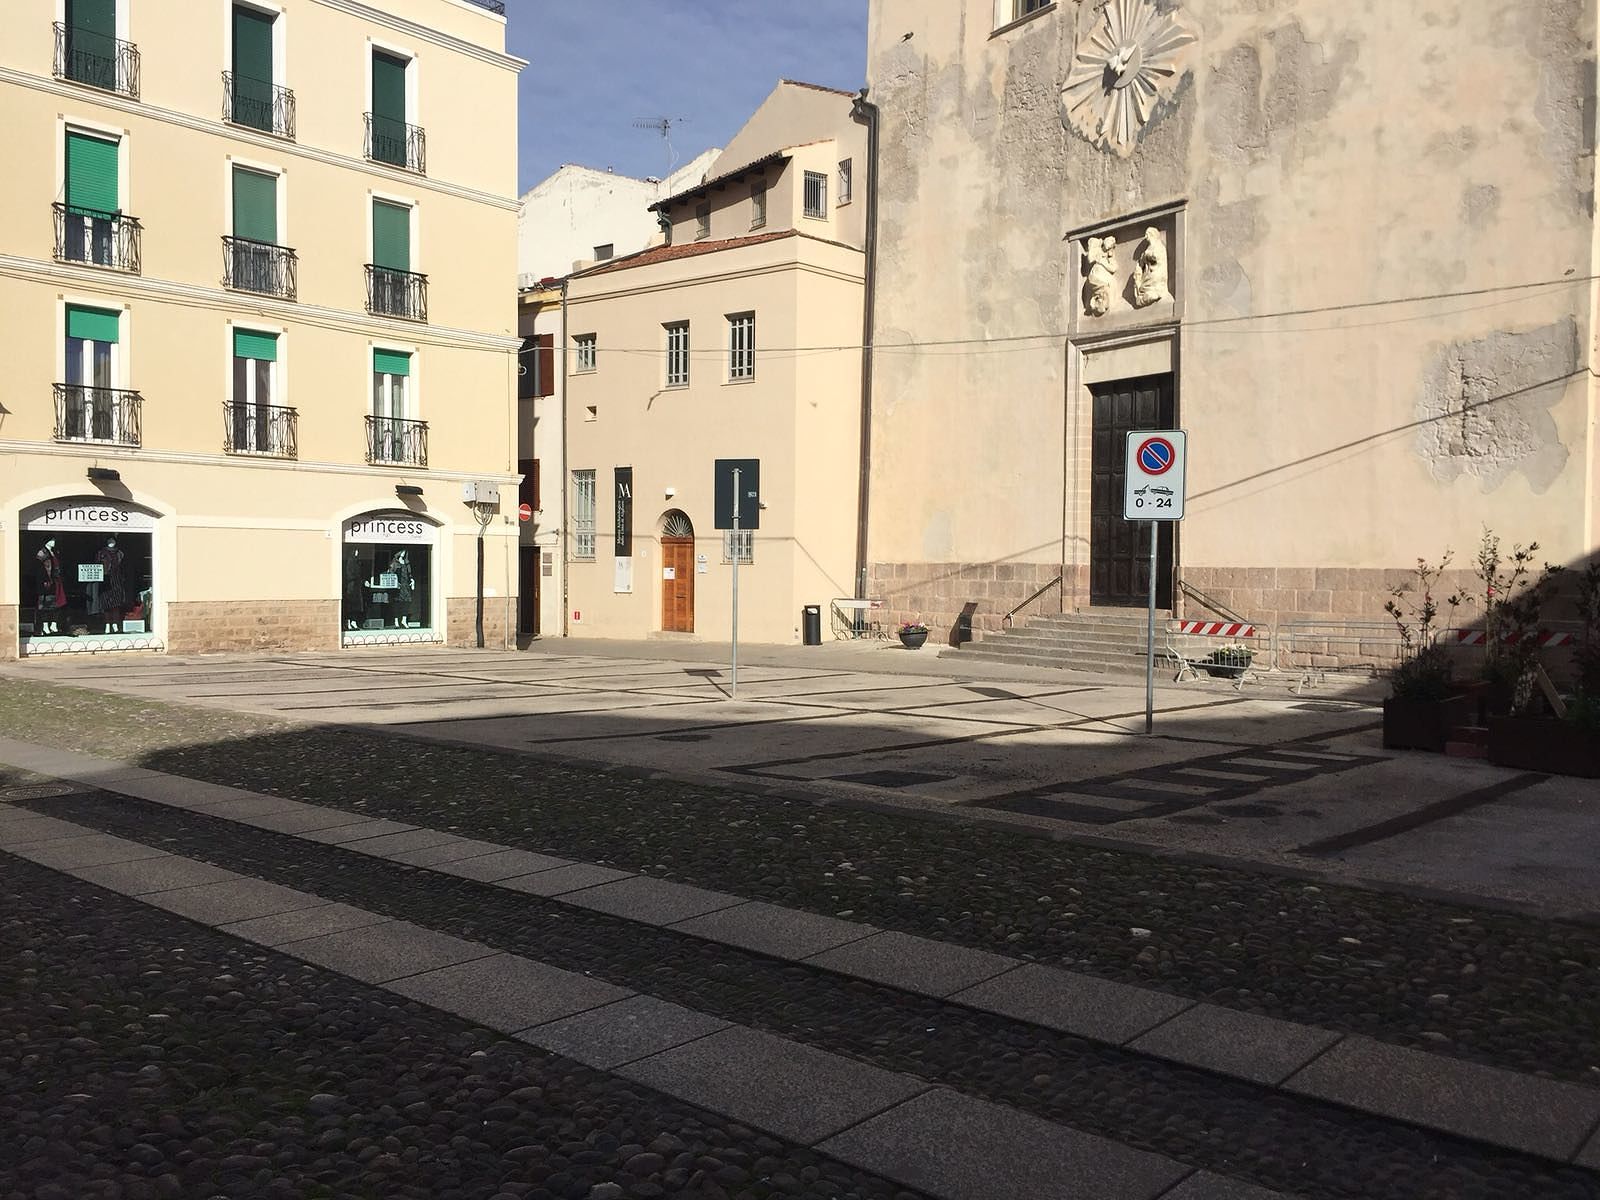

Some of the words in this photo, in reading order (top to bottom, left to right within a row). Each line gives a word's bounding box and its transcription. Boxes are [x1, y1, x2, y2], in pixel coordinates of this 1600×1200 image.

[1135, 498, 1144, 508] 0
[1156, 498, 1172, 508] 24
[45, 503, 129, 524] princess
[351, 517, 423, 537] princess
